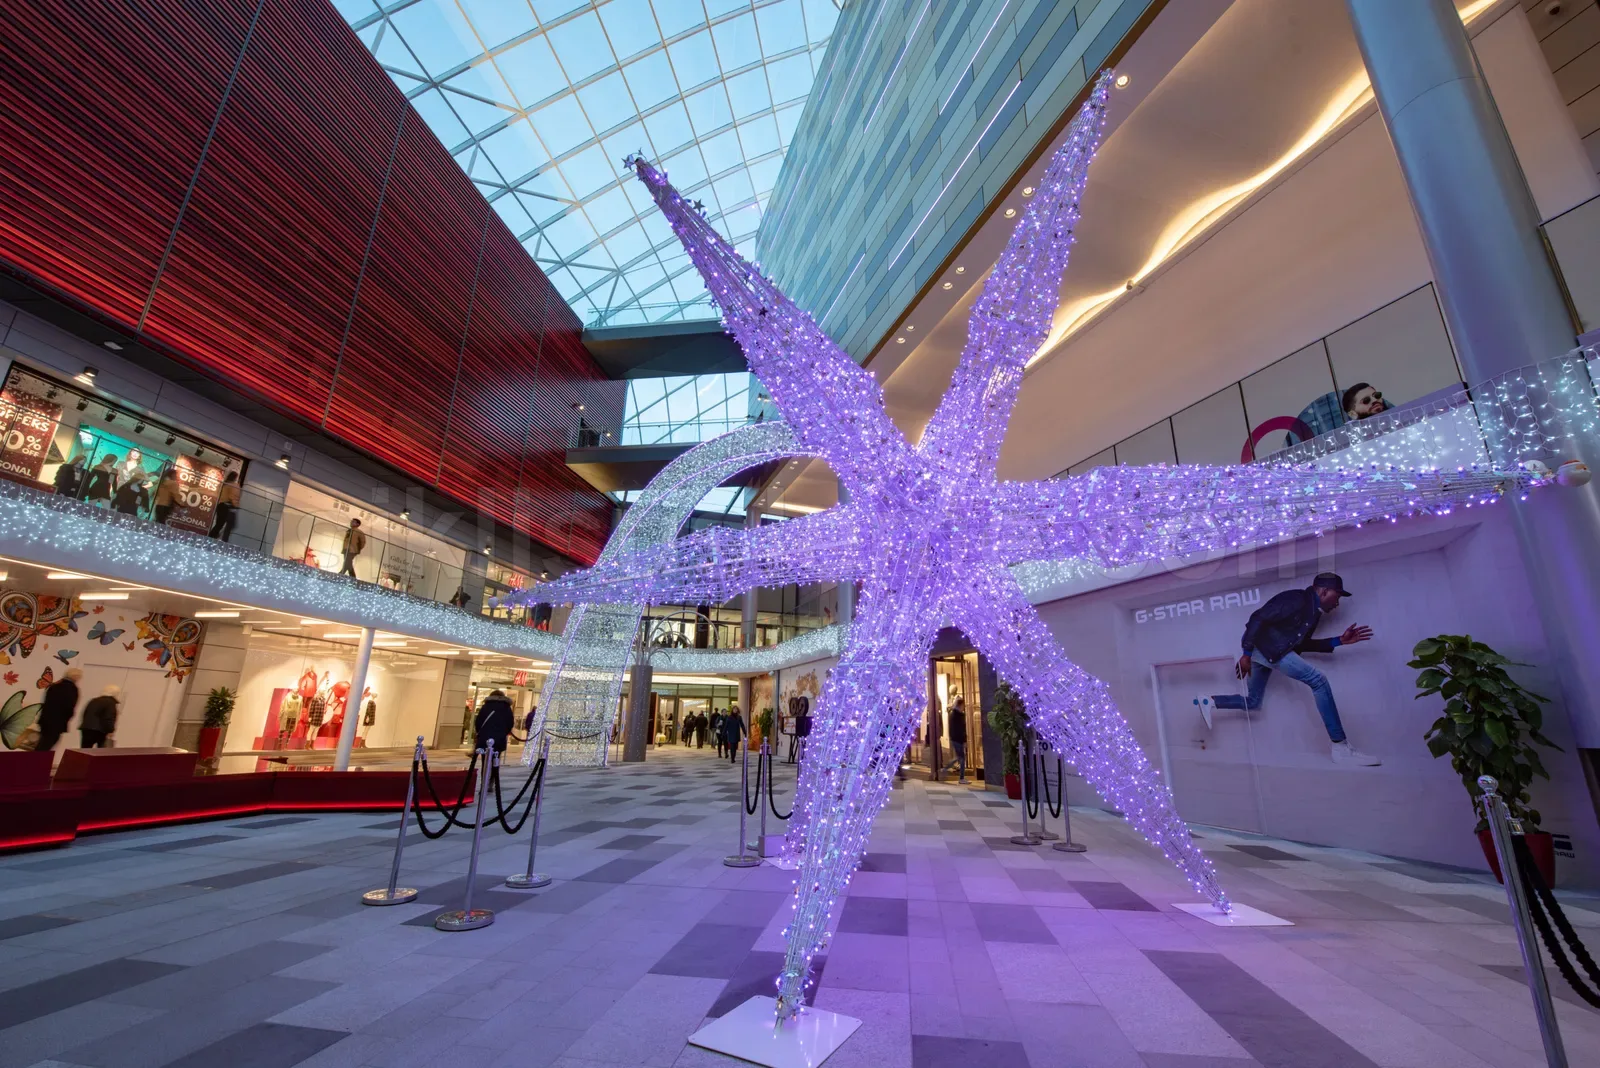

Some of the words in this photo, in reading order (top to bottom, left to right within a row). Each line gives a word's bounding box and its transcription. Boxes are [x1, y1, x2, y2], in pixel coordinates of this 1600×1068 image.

[22, 447, 40, 457] OFF
[179, 472, 218, 491] OFFERS
[199, 504, 212, 513] OFF
[1135, 599, 1205, 624] G-STAR
[1209, 588, 1261, 611] RAW
